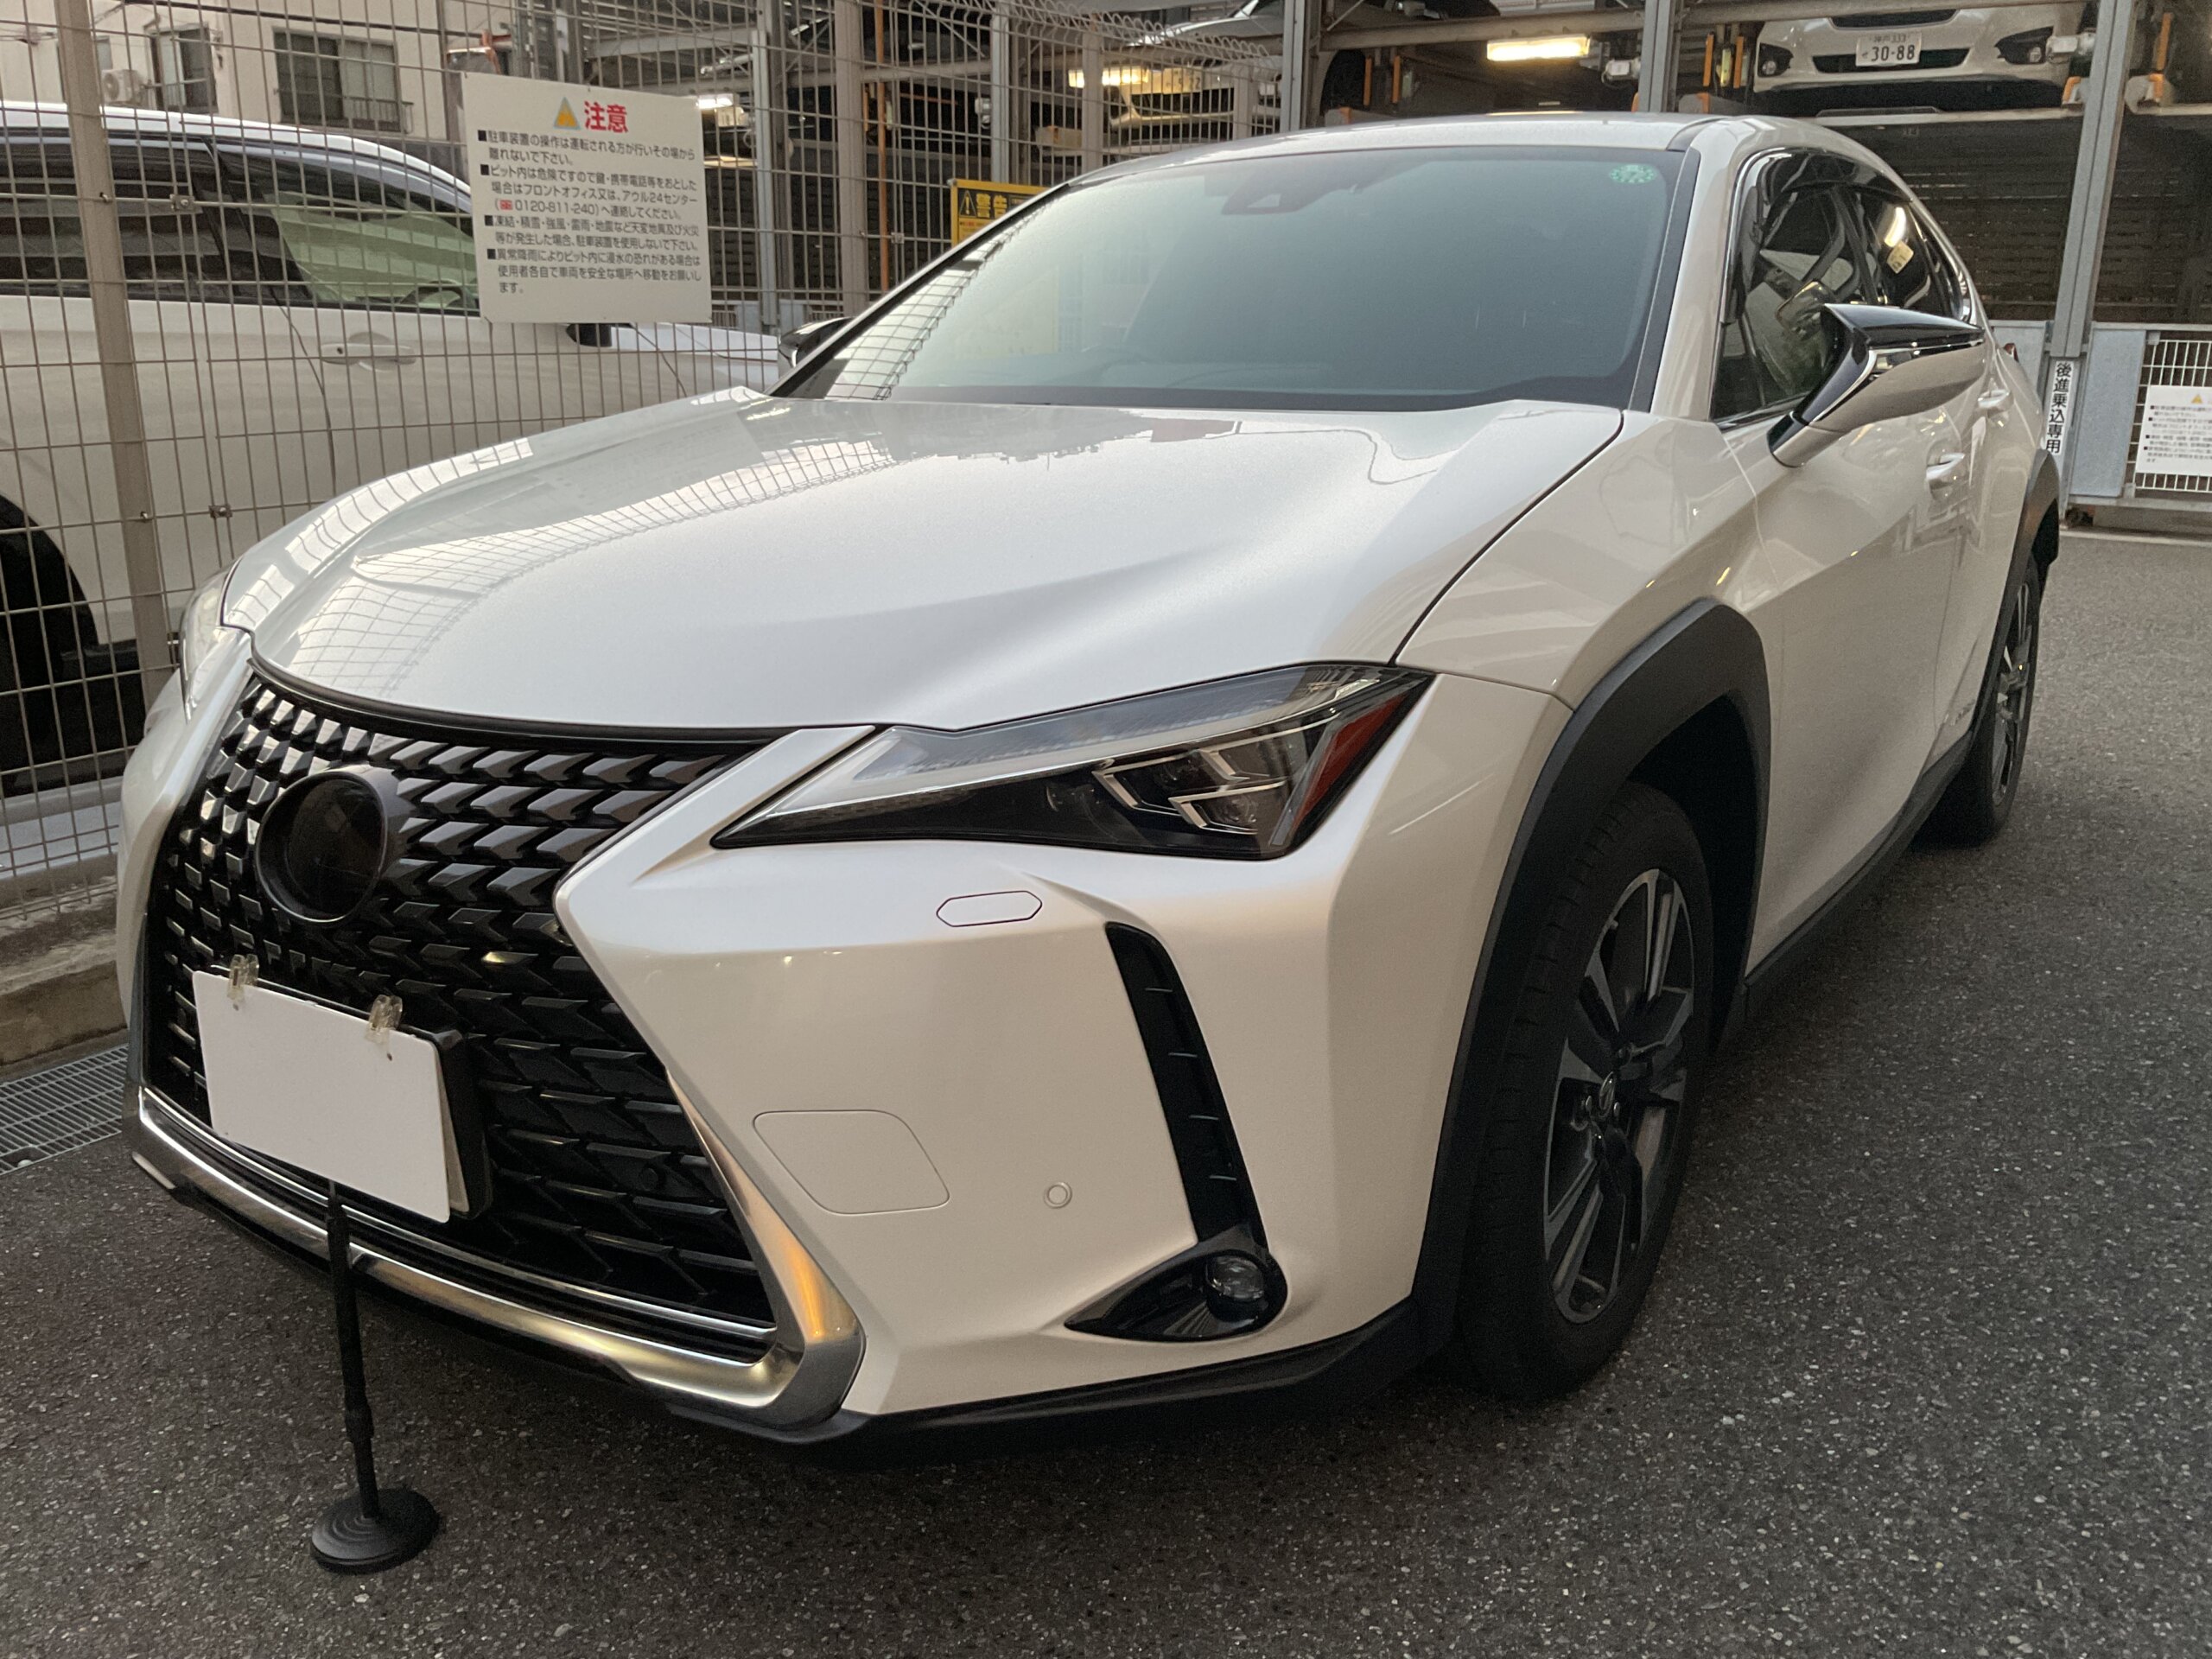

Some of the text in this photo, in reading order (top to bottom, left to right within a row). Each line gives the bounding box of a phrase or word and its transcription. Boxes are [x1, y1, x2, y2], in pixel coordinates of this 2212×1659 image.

[1871, 44, 1916, 62] 30-88
[584, 101, 629, 132] 注意
[489, 147, 574, 165] 離れないで下さい。
[976, 193, 1008, 219] 警告
[499, 282, 524, 294] ます。
[2045, 362, 2072, 454] 後進乗込専用
